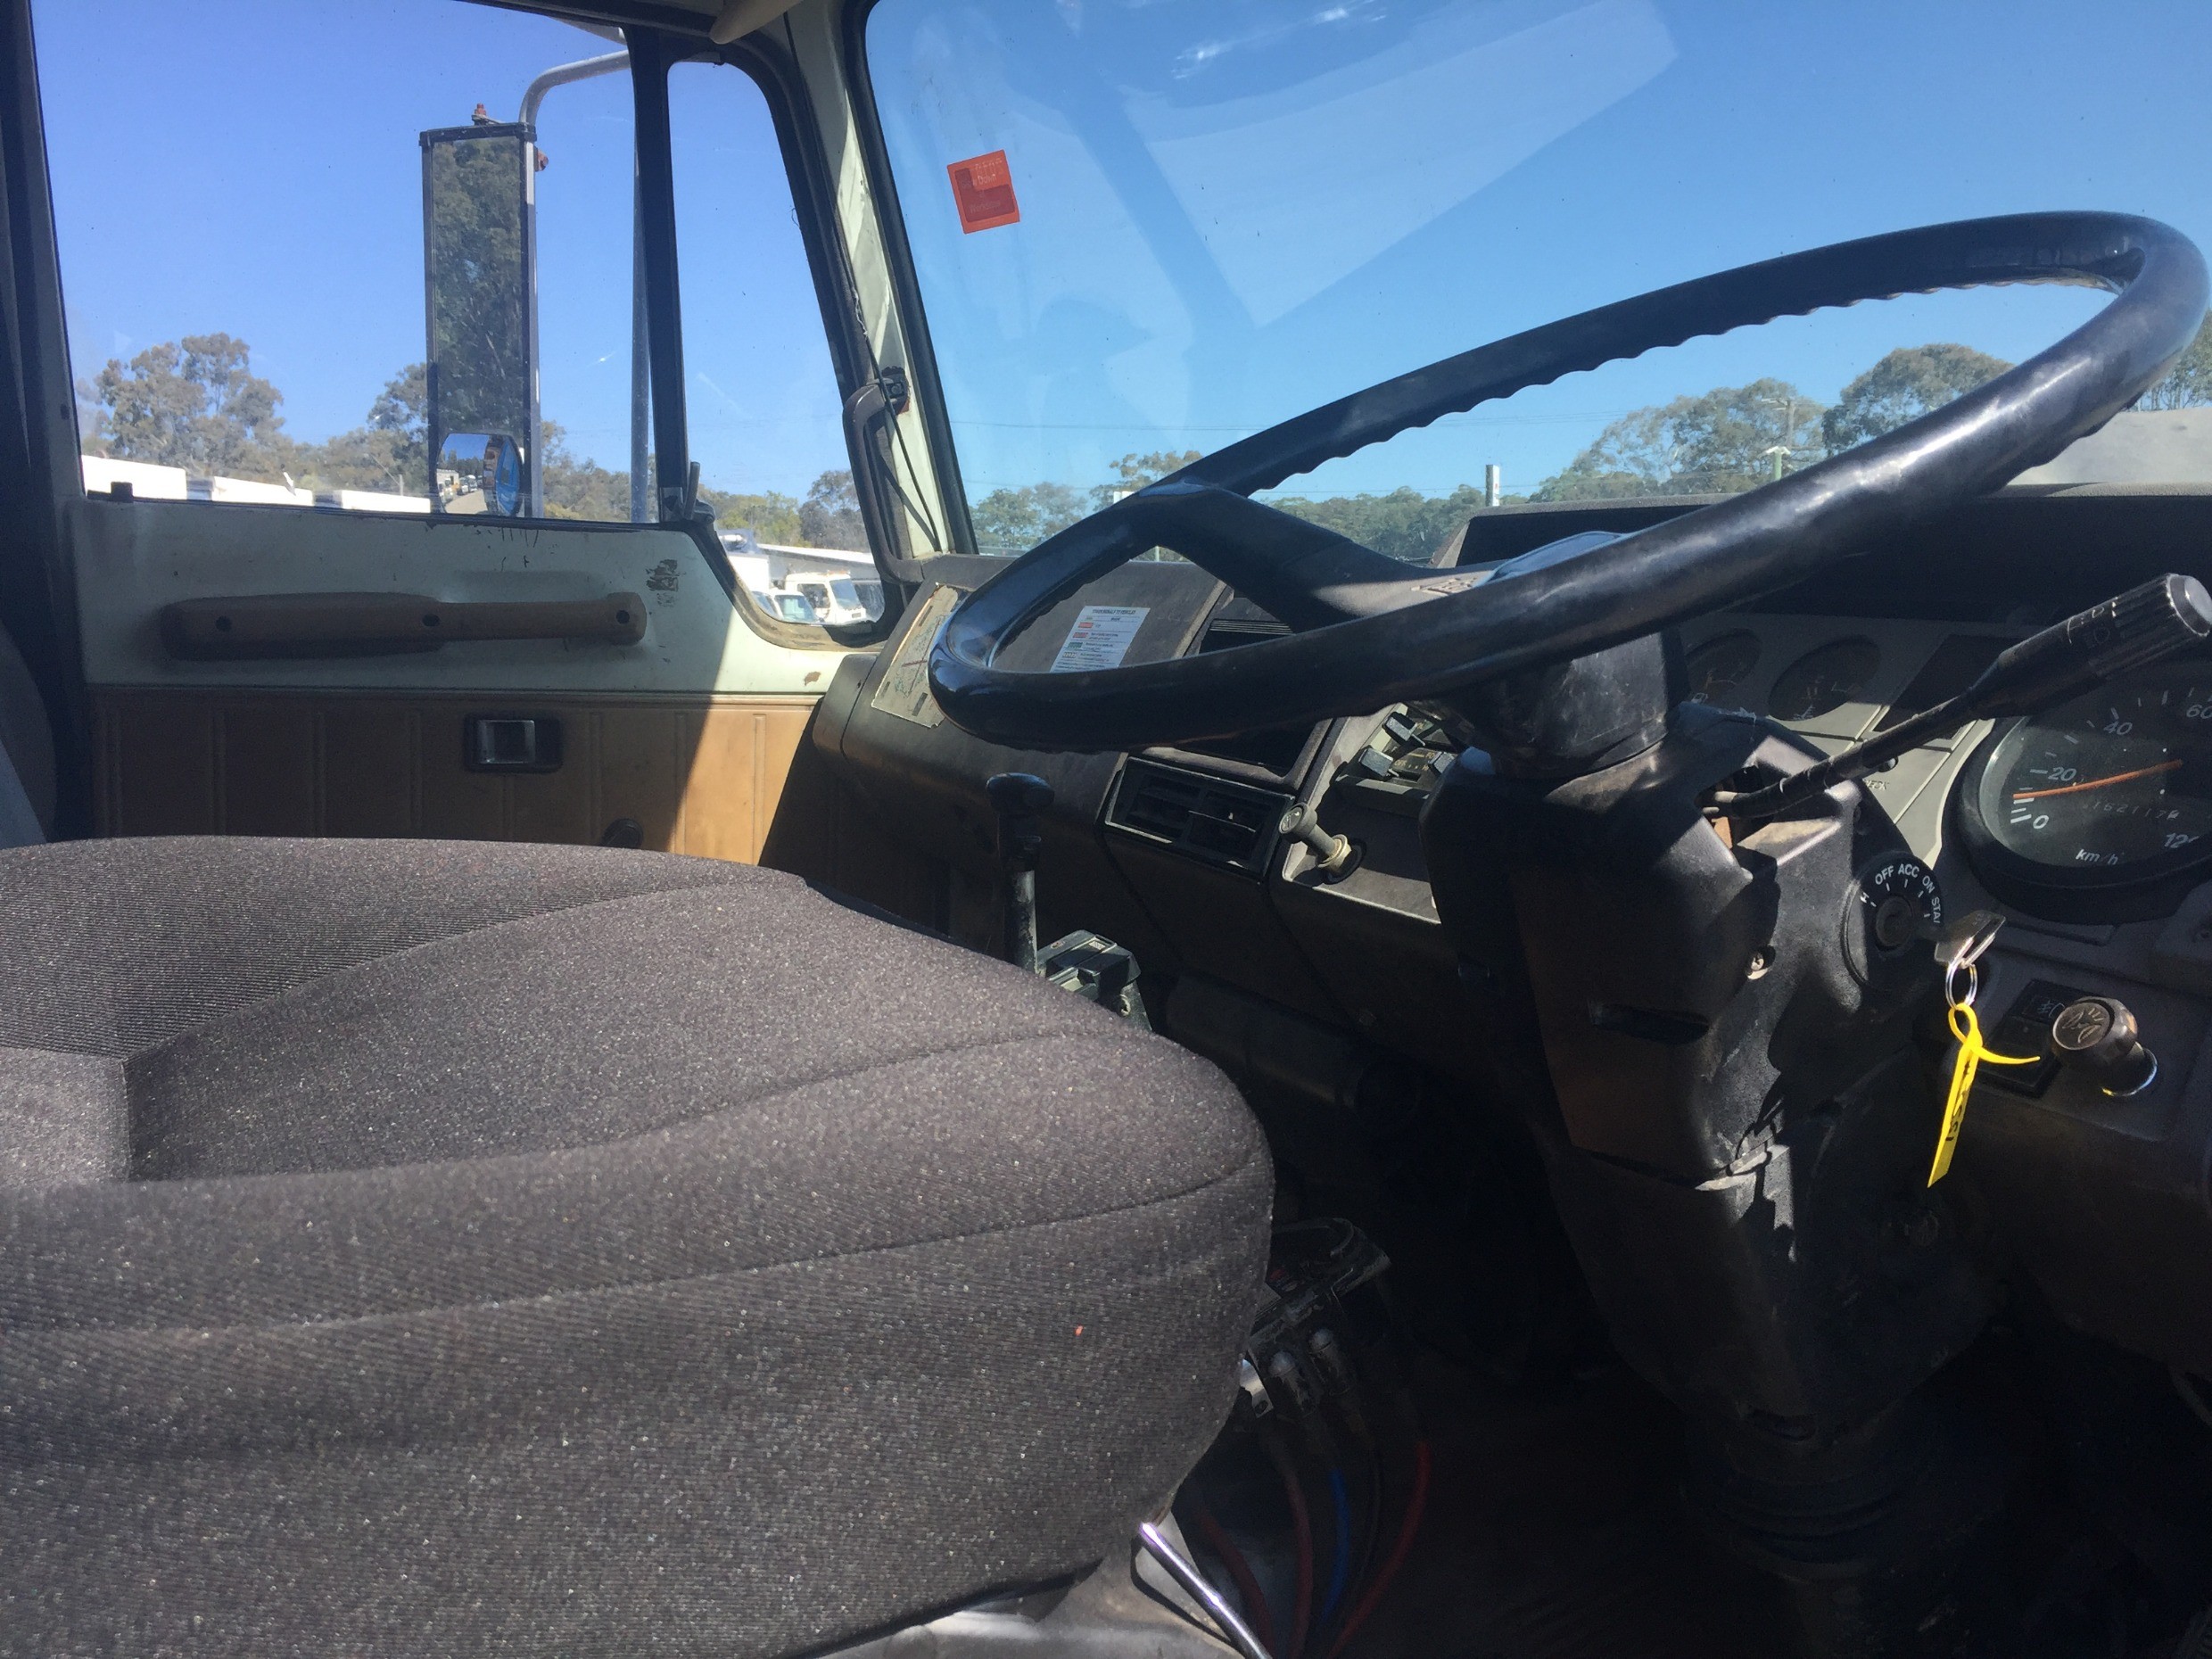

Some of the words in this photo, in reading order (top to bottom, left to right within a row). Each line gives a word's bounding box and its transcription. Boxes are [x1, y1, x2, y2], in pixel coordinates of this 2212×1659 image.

[2186, 704, 2212, 720] 60
[2103, 721, 2134, 736] 40
[2048, 766, 2077, 781] 20
[2033, 814, 2050, 830] 0
[2075, 848, 2119, 865] km/h
[1875, 865, 1894, 885] OFF
[1897, 863, 1920, 879] ACC
[1922, 875, 1936, 894] ON
[1931, 896, 1941, 924] STA
